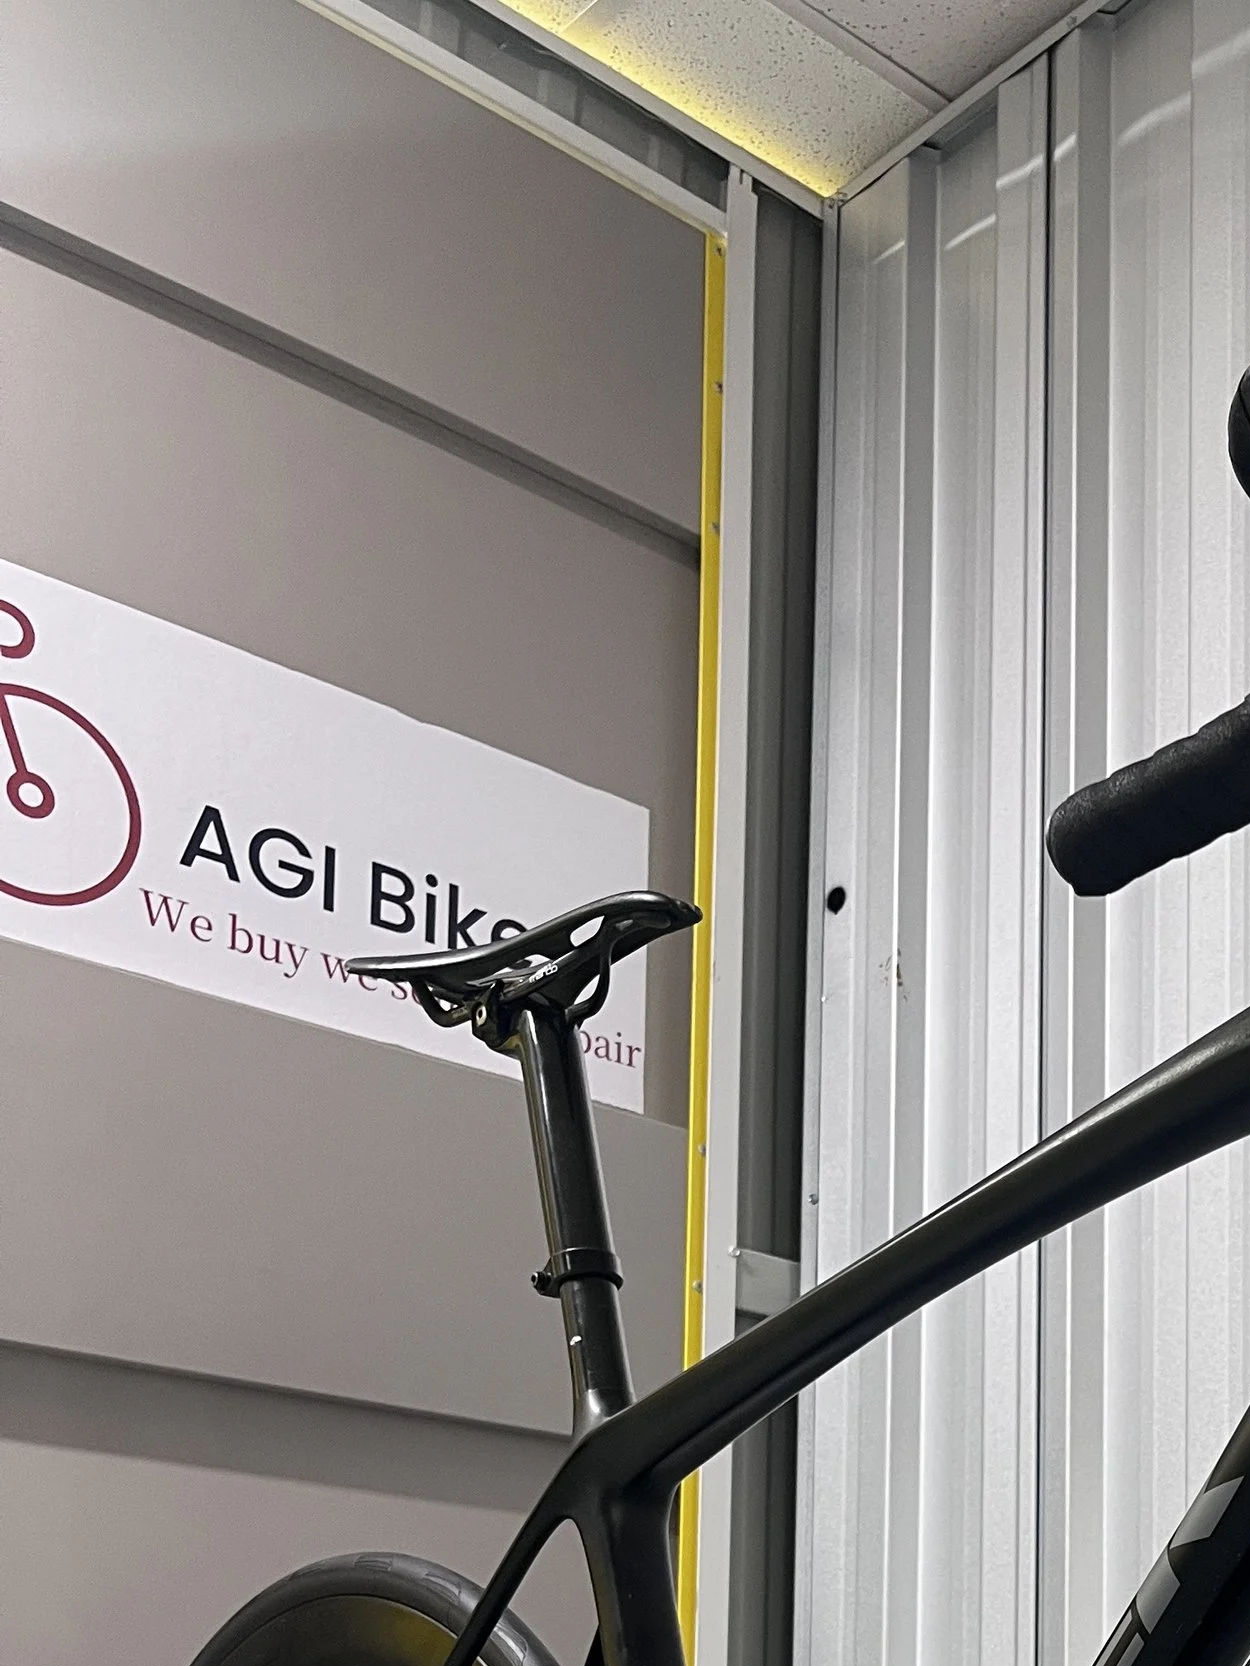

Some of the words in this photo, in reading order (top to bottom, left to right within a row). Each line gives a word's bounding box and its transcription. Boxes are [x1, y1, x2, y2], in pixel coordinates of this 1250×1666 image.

[180, 804, 337, 912] AGI
[139, 888, 213, 942] We
[227, 913, 309, 979] buy
